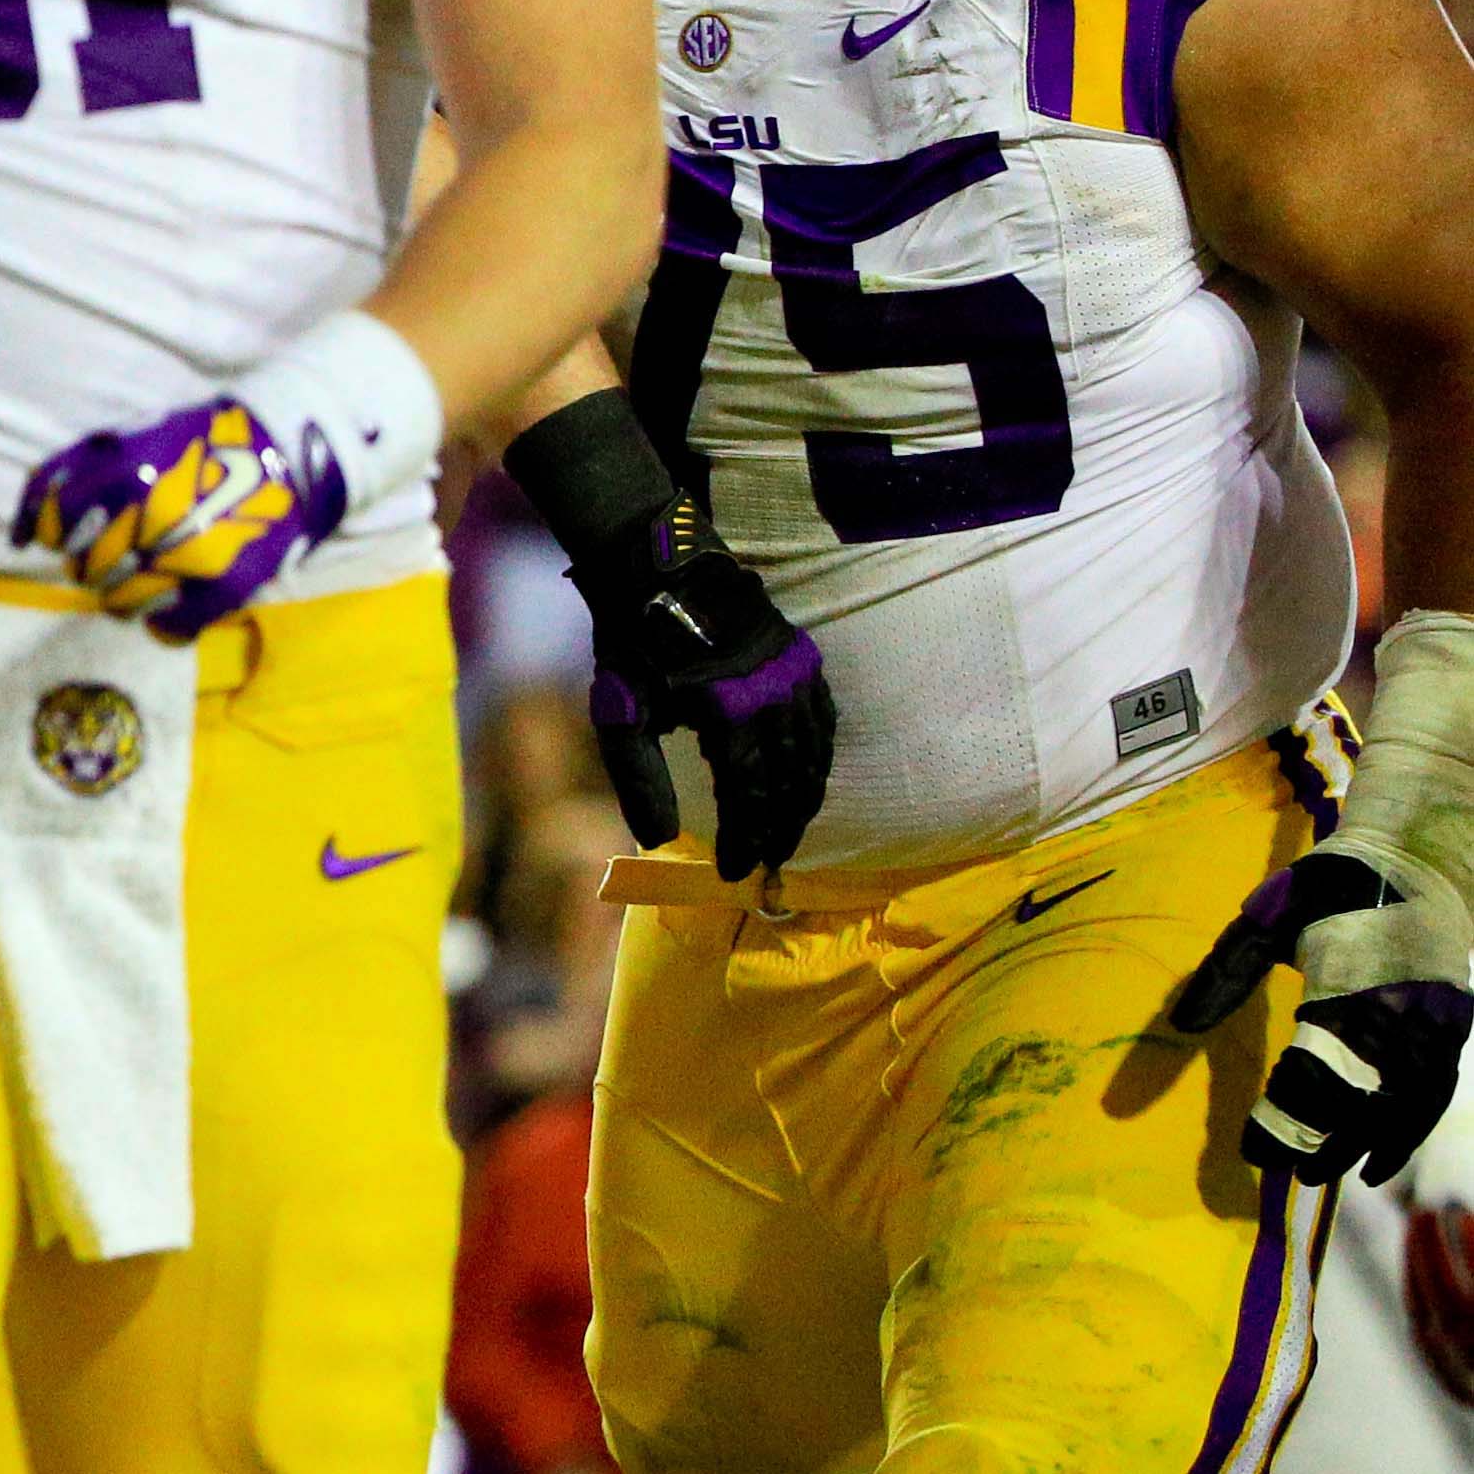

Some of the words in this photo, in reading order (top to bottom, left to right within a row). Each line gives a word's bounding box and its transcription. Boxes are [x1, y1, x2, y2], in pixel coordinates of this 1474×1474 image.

[684, 17, 730, 68] SEC
[677, 114, 780, 152] LSU
[629, 130, 1077, 546] 75
[1134, 691, 1166, 718] 46
